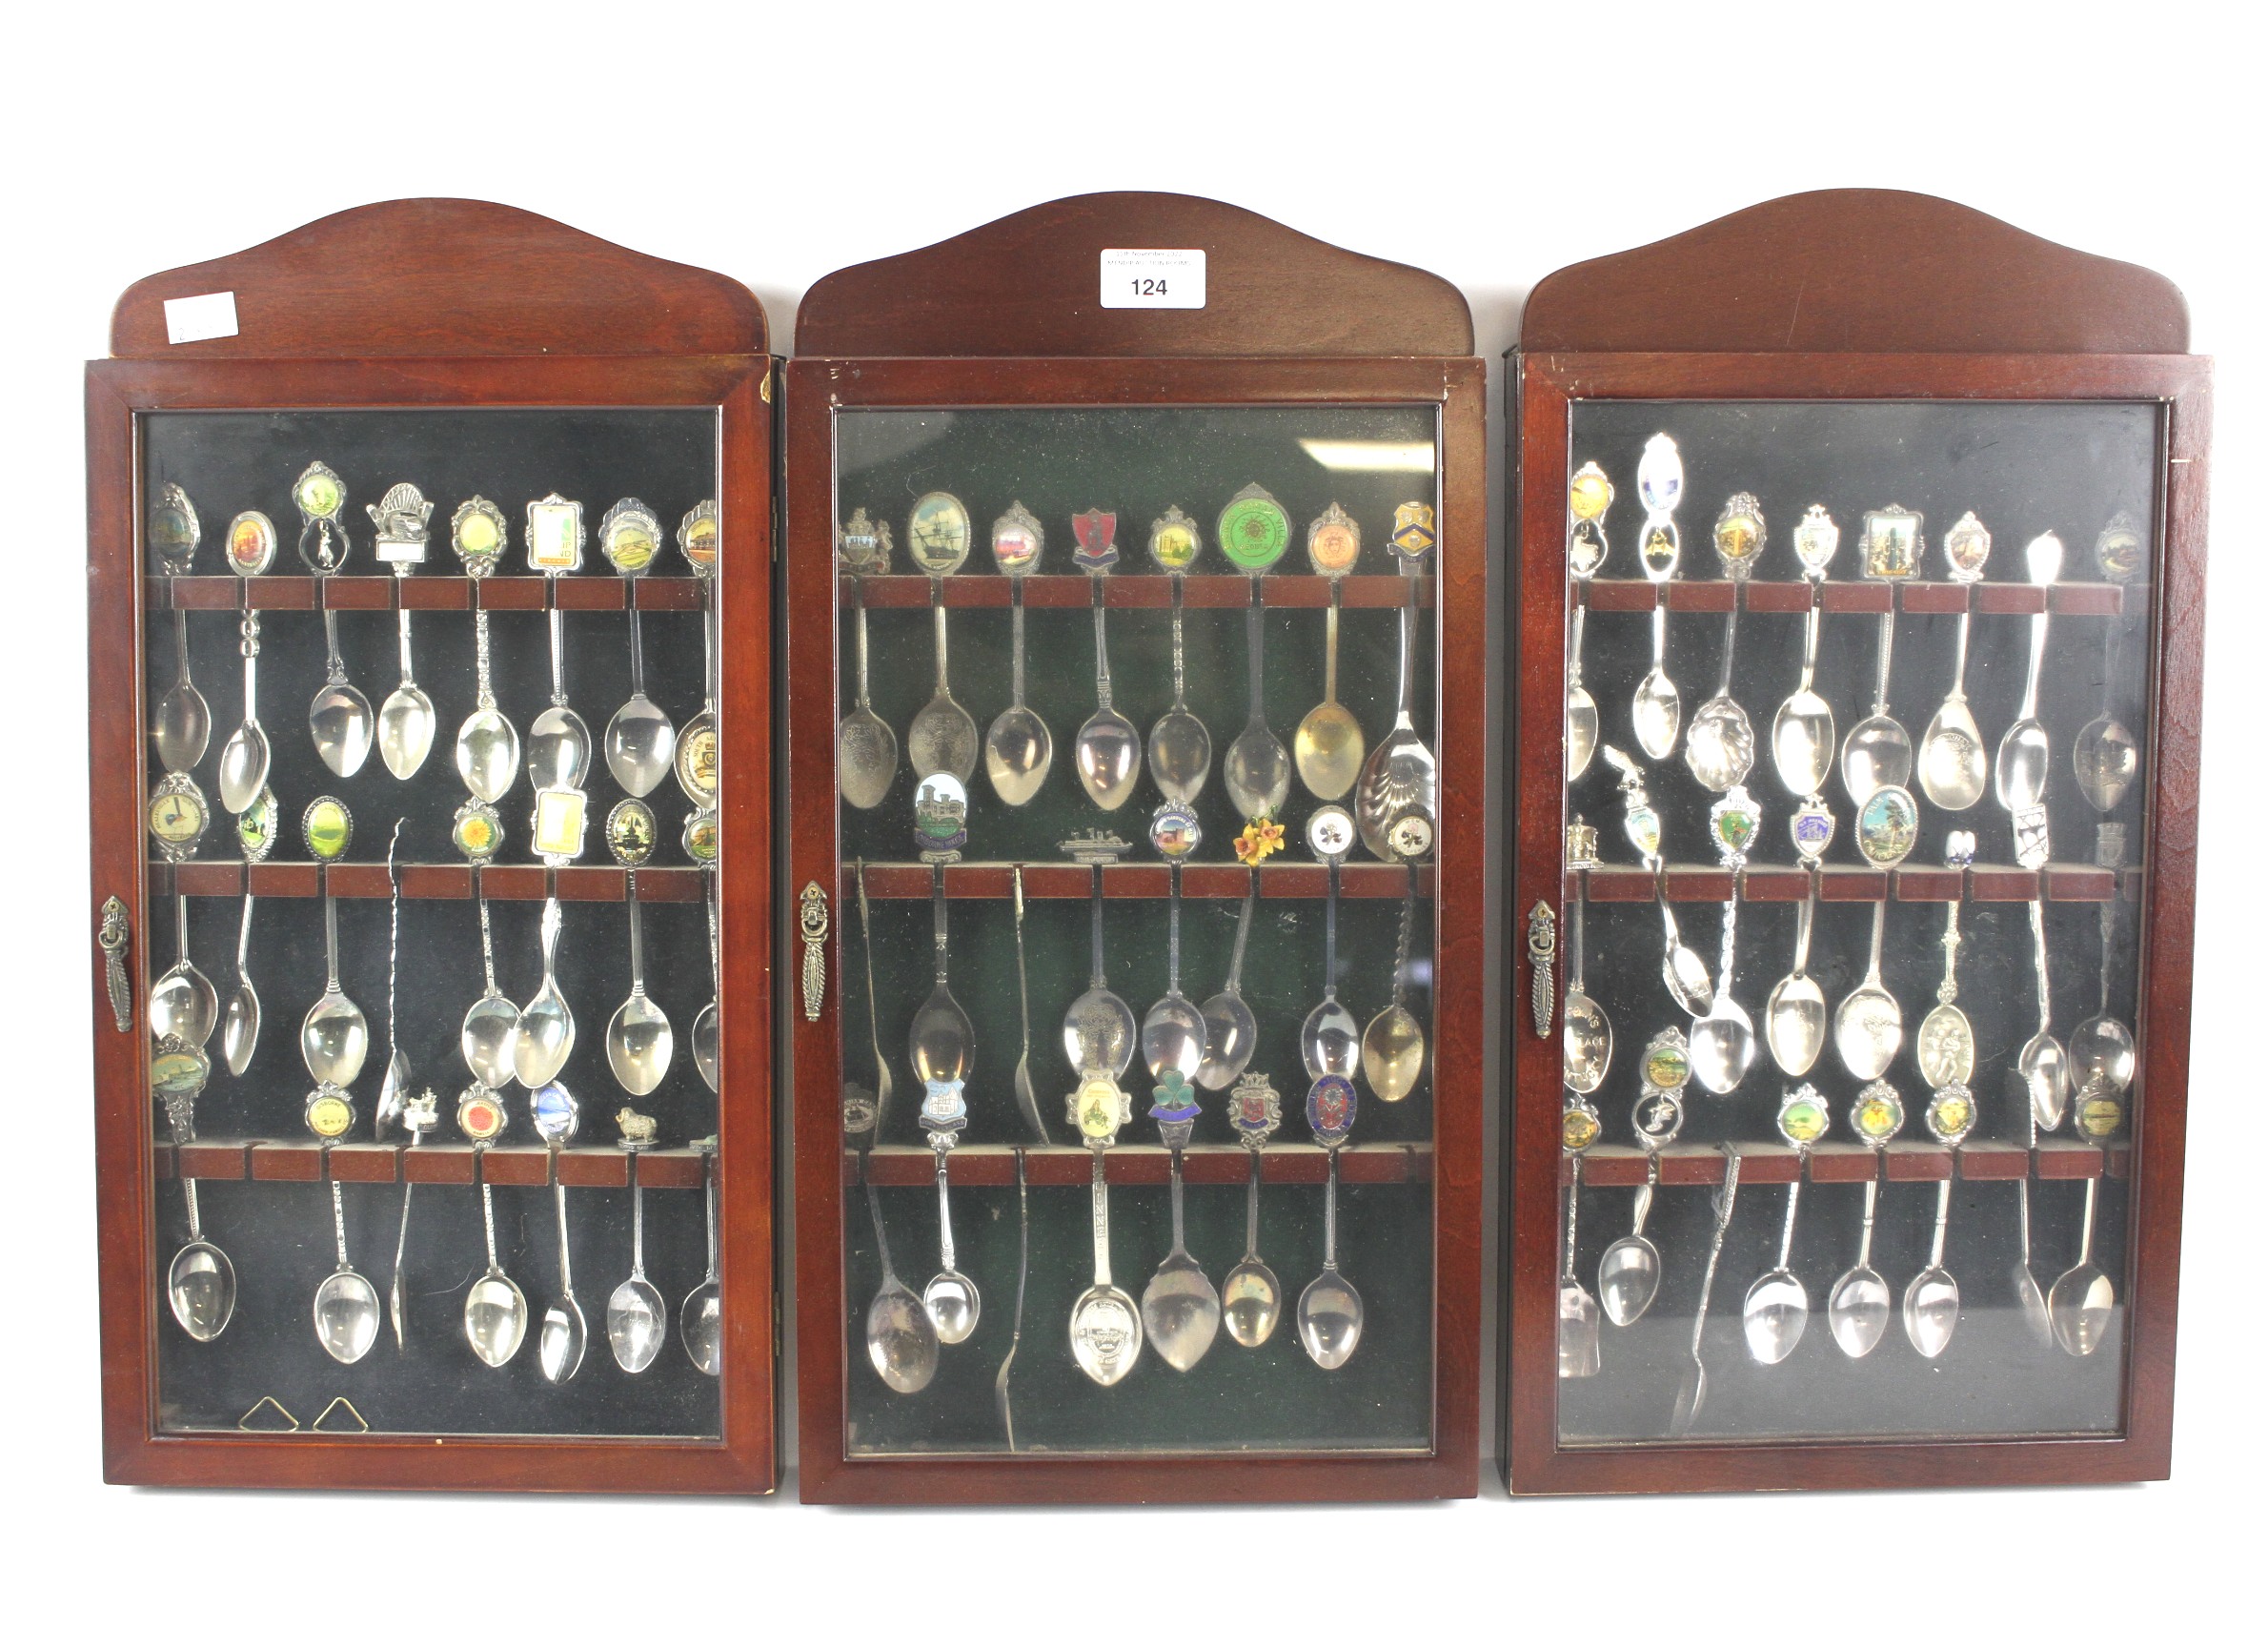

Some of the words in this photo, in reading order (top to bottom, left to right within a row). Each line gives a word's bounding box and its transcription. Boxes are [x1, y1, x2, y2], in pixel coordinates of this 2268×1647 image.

[1131, 278, 1168, 295] 124
[1865, 796, 1884, 816] PALM
[1574, 1036, 1608, 1047] PLACE
